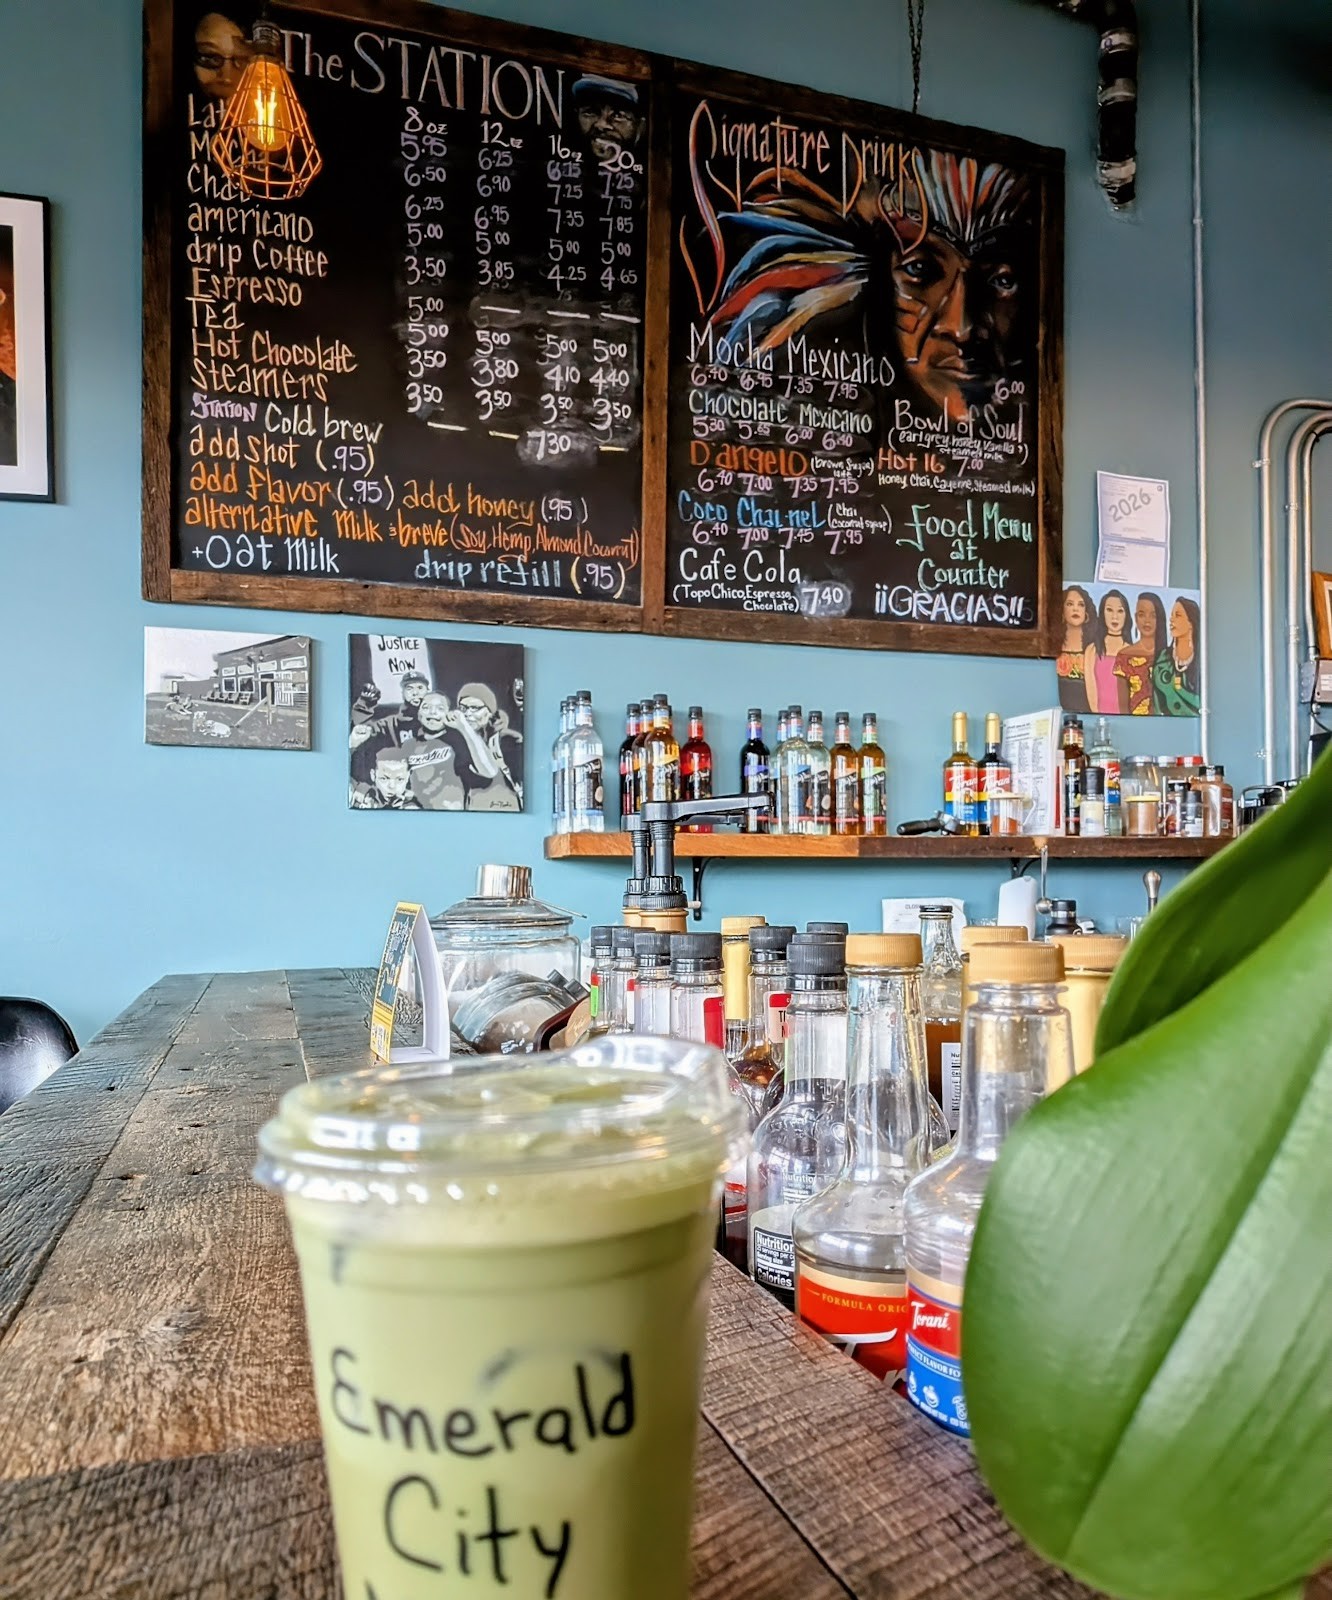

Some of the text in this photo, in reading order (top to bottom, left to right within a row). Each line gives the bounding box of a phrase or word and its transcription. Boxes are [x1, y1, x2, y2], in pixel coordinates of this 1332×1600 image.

[280, 29, 566, 130] The STATION
[188, 93, 228, 127] Lat
[400, 132, 447, 161] 5.95
[478, 147, 513, 171] 6.25
[404, 163, 446, 188] 6.50
[477, 174, 511, 197] 6.90
[547, 183, 583, 205] 7.25
[404, 194, 444, 219] 6.25
[474, 205, 510, 229] 6.95
[547, 208, 585, 234] 7.35
[186, 233, 242, 275] drip
[407, 223, 443, 247] 5.00
[191, 267, 302, 306] Espresso
[405, 255, 446, 285] 3.50
[478, 259, 514, 285] 3.85
[547, 264, 587, 291] 4.25
[185, 297, 245, 329] Tea
[408, 296, 444, 322] 5.00
[191, 328, 358, 373] Hot Chocolate
[686, 321, 895, 387] Mocha Mexicano
[778, 374, 814, 399] 7.35
[823, 380, 858, 402] 7.95
[265, 402, 317, 436] Cold
[325, 406, 384, 443] brew
[688, 388, 873, 434] Chocolate Mexicano
[895, 397, 1024, 443] Bowl of Soul
[190, 424, 240, 461] add
[316, 440, 376, 477] (.95)
[877, 447, 984, 477] Hot 16 7.00
[190, 461, 239, 493] add
[338, 475, 395, 510] (.95)
[403, 479, 460, 514] add
[467, 482, 535, 530] honey
[697, 467, 733, 492] 6.40
[783, 476, 818, 498] 7.35
[820, 477, 860, 499] 7.95
[185, 494, 318, 537] alternative
[398, 508, 449, 549] breve
[678, 489, 728, 522] Coco
[1109, 488, 1151, 522] 2026
[692, 521, 728, 544] 6.40
[824, 530, 863, 555] 7.95
[896, 499, 1033, 551] Food Menu
[415, 549, 473, 588] drip
[480, 554, 561, 588] refill
[679, 547, 801, 584] Cafe Cola
[950, 538, 978, 561] at
[918, 558, 1010, 591] Counter
[758, 1268, 792, 1287] Calories
[822, 1293, 874, 1312] FORMULA
[910, 1300, 952, 1331] Torani
[923, 1355, 962, 1378] FLAVOR FO
[331, 1346, 636, 1458] Emerald
[384, 1474, 573, 1600] City
